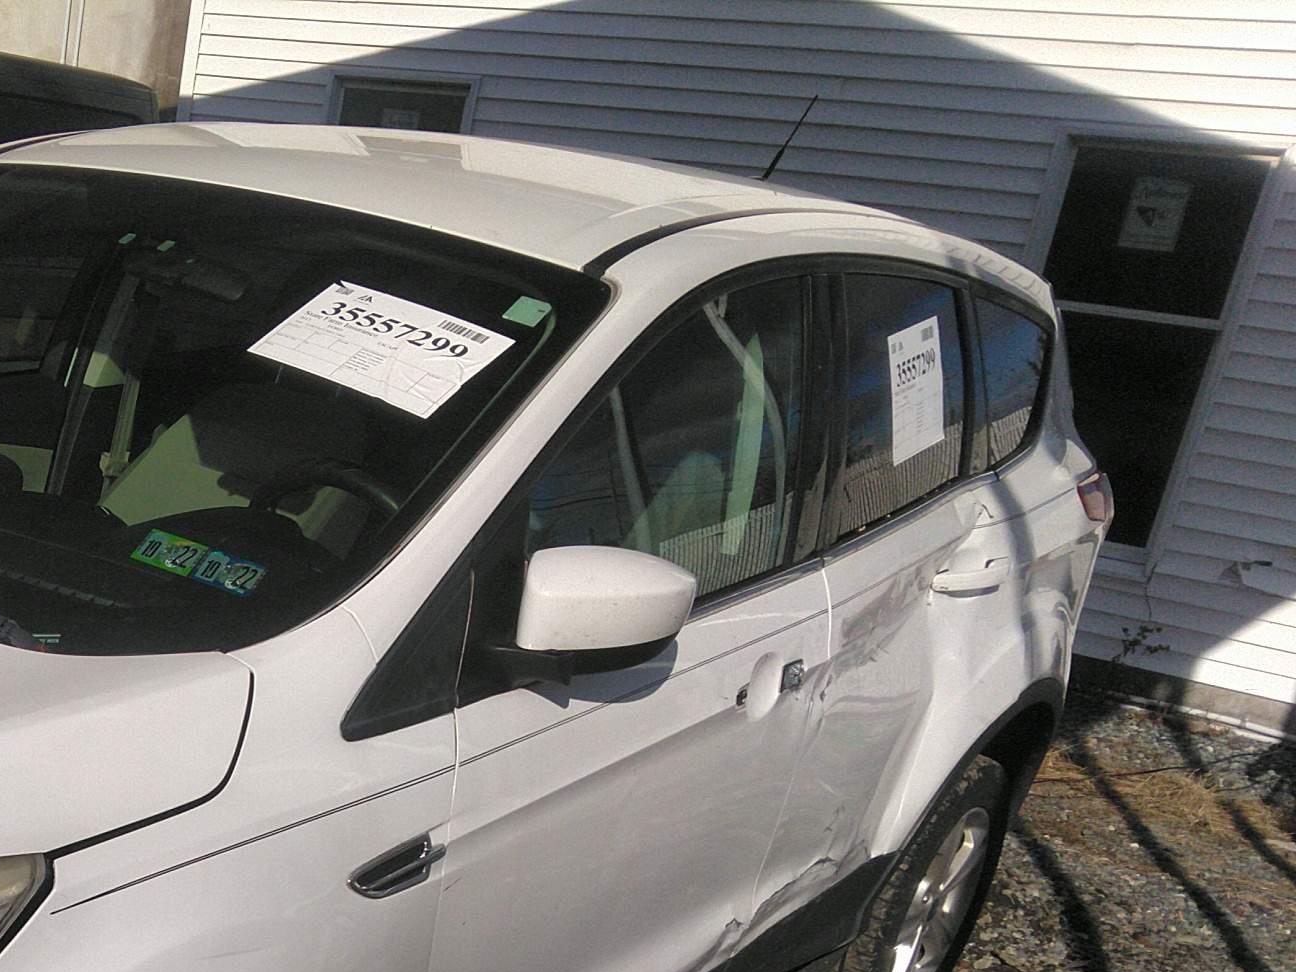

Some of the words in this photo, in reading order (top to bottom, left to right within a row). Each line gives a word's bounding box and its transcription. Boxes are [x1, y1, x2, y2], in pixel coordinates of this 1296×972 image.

[320, 301, 469, 359] 35557299
[896, 347, 935, 387] 35557299
[171, 545, 199, 568] 22
[230, 566, 258, 590] 22
